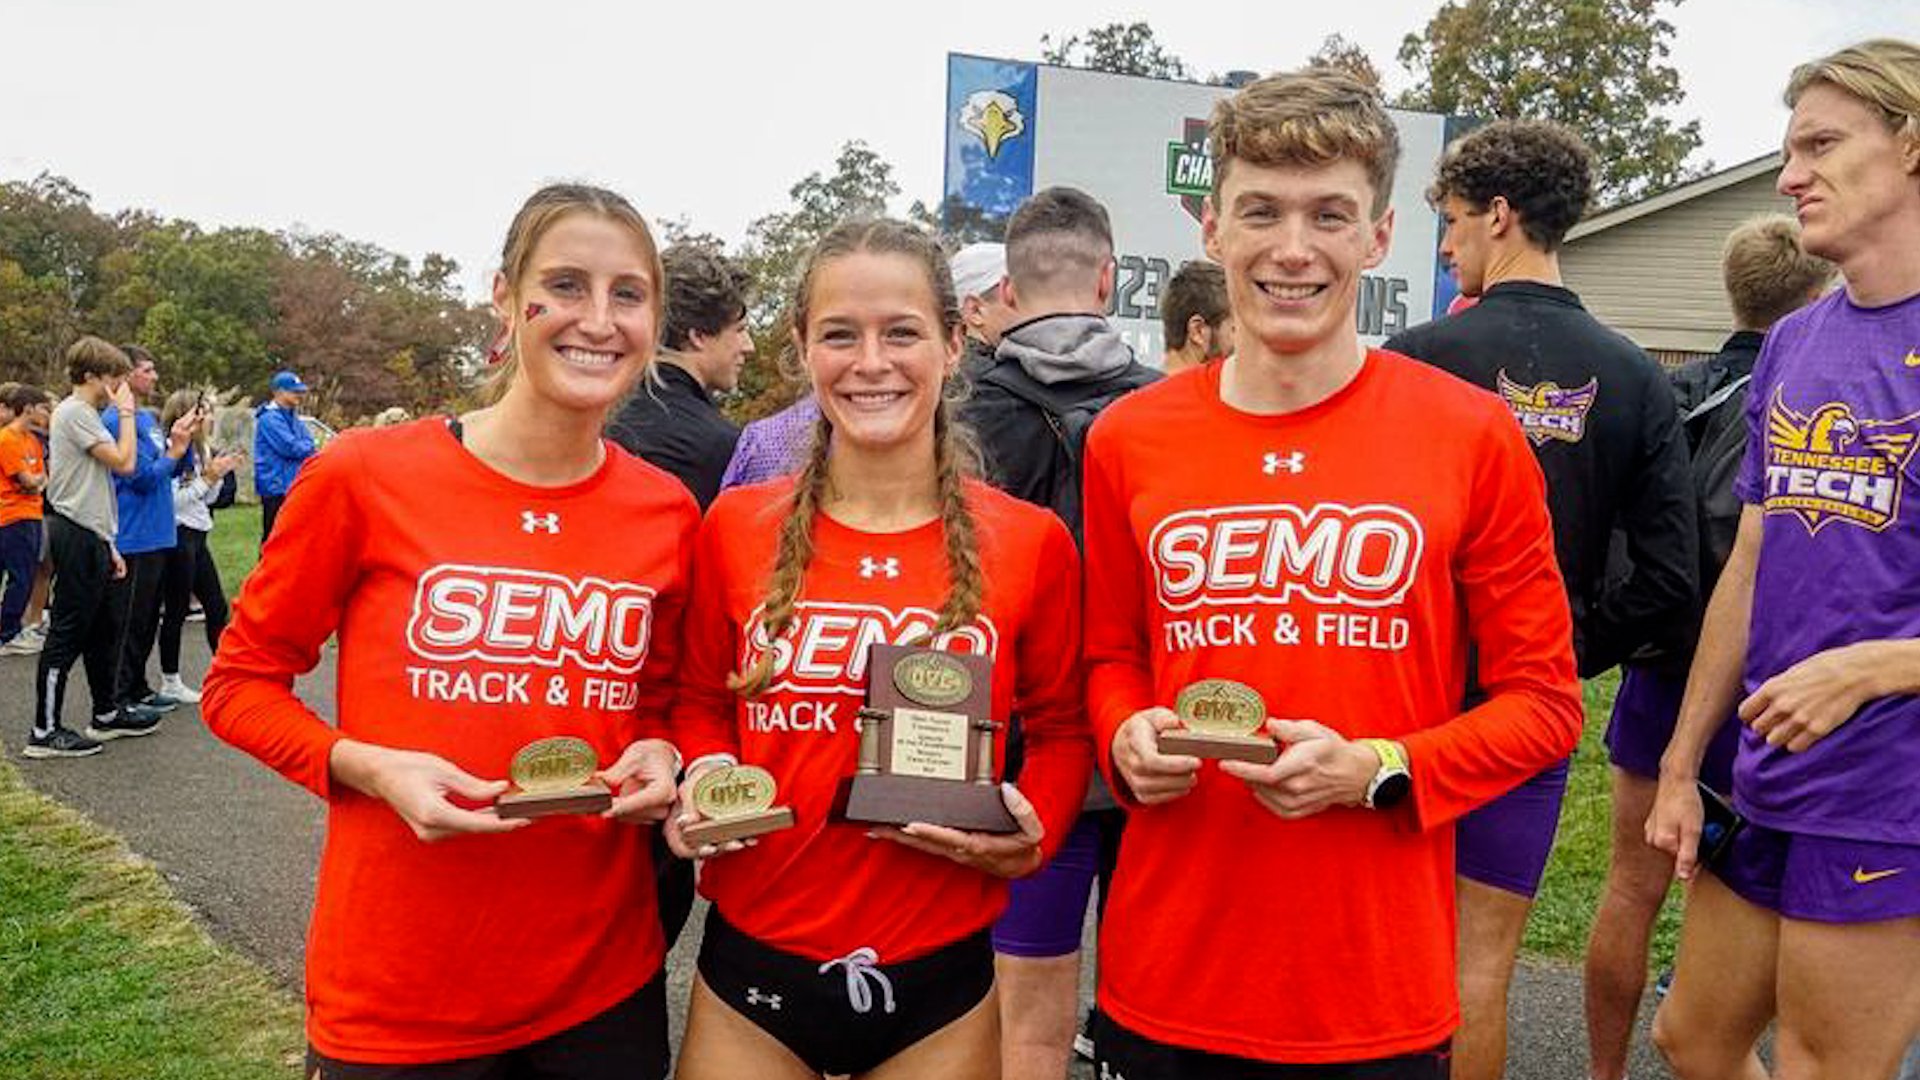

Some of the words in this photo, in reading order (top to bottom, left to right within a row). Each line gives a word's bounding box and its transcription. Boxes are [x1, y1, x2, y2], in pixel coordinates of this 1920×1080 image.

[1174, 153, 1213, 187] CHA
[1772, 447, 1887, 475] TENNESSEE
[1766, 465, 1896, 514] TECH
[1157, 513, 1413, 600] SEMO
[416, 572, 653, 666] SEMO
[1164, 614, 1257, 652] TRACK
[1273, 613, 1301, 646] &
[1316, 614, 1409, 650] FIELD
[406, 667, 532, 706] TRACK
[545, 677, 570, 707] &
[746, 700, 838, 735] TRACK
